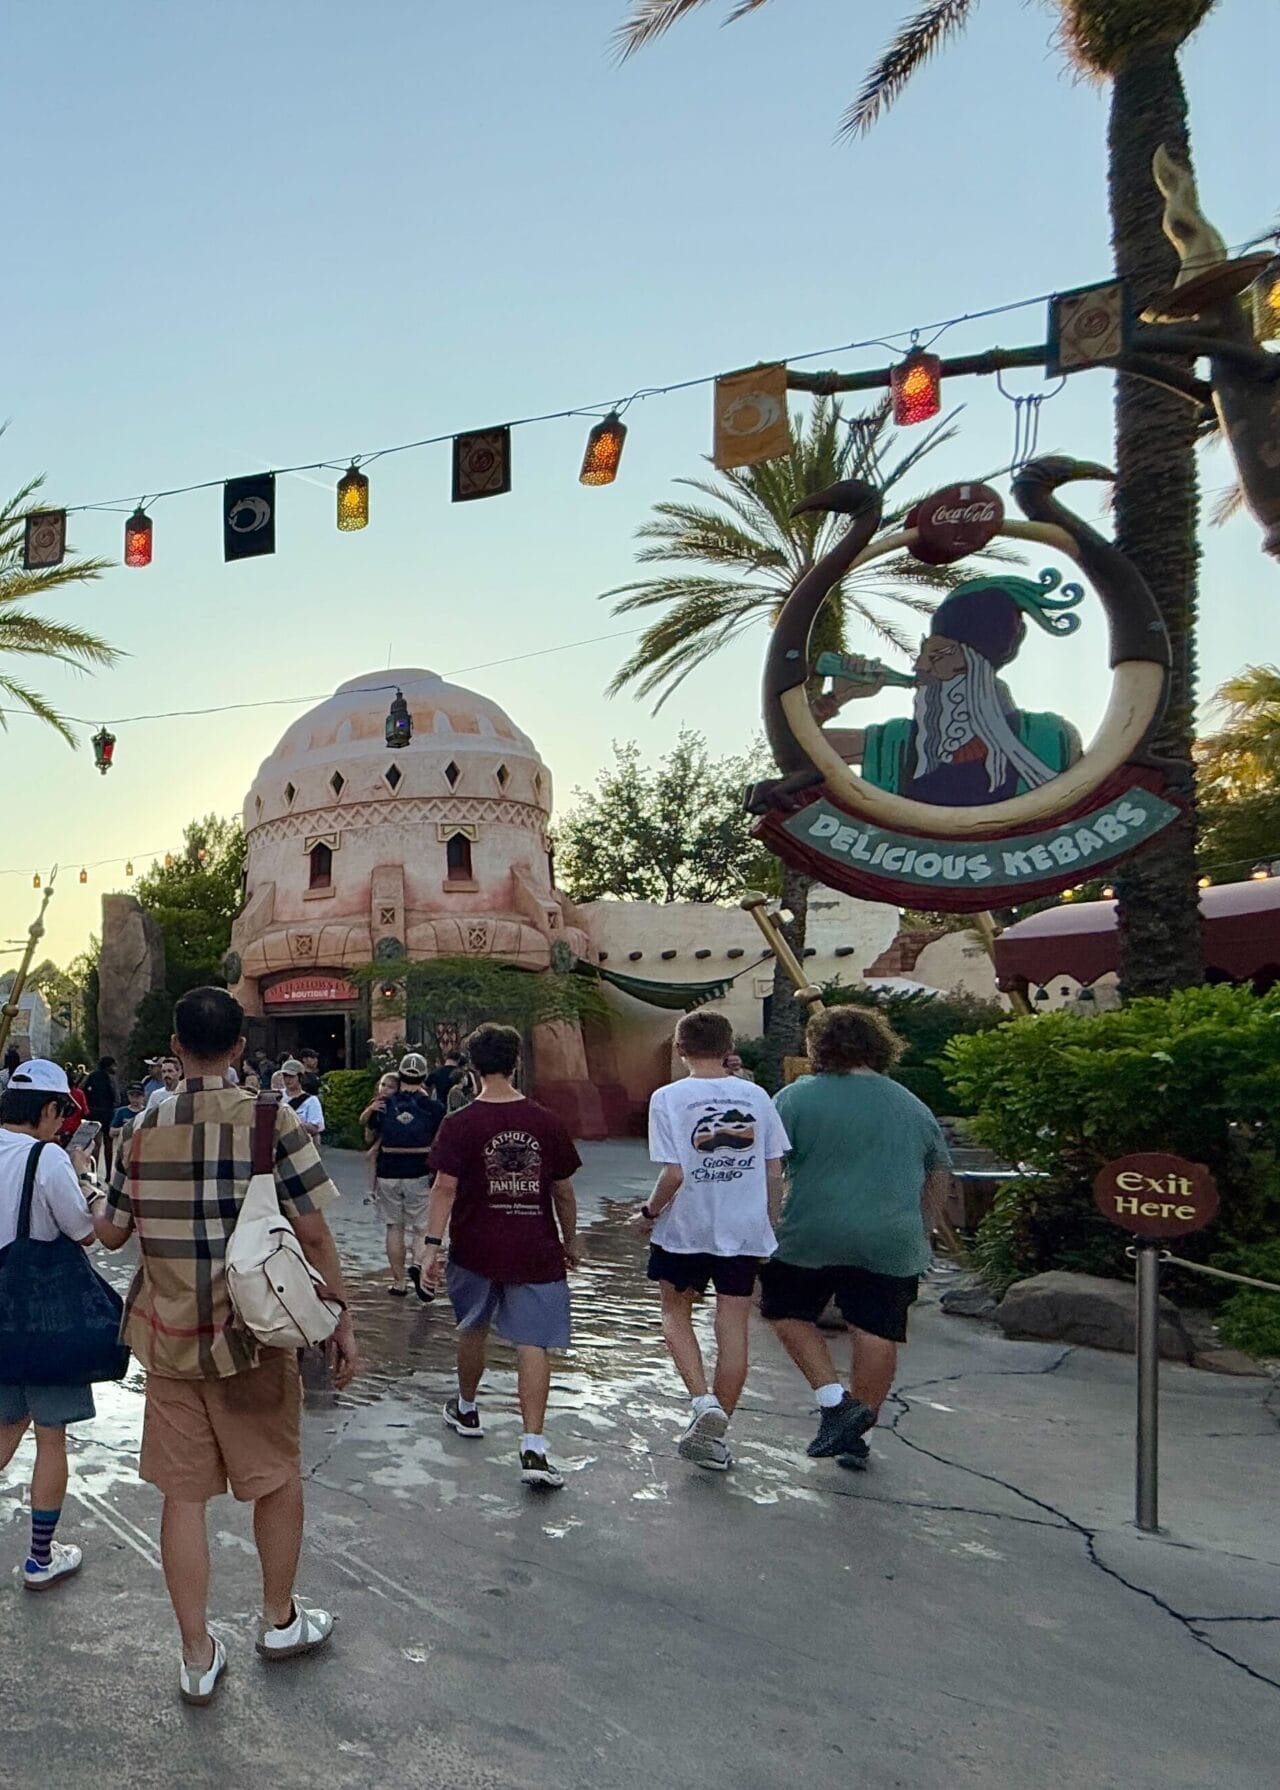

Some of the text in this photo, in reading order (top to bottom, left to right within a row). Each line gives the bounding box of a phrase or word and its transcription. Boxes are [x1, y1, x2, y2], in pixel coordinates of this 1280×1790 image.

[931, 501, 996, 526] Coca-Cola
[808, 801, 1147, 881] DELICIOUS KEBABS
[291, 989, 329, 999] BOUTIQUE
[485, 1132, 540, 1156] CATHOLIC
[738, 1155, 756, 1167] of
[489, 1180, 540, 1194] PANTHERS
[1116, 1171, 1194, 1196] Exit
[1113, 1195, 1197, 1220] Here
